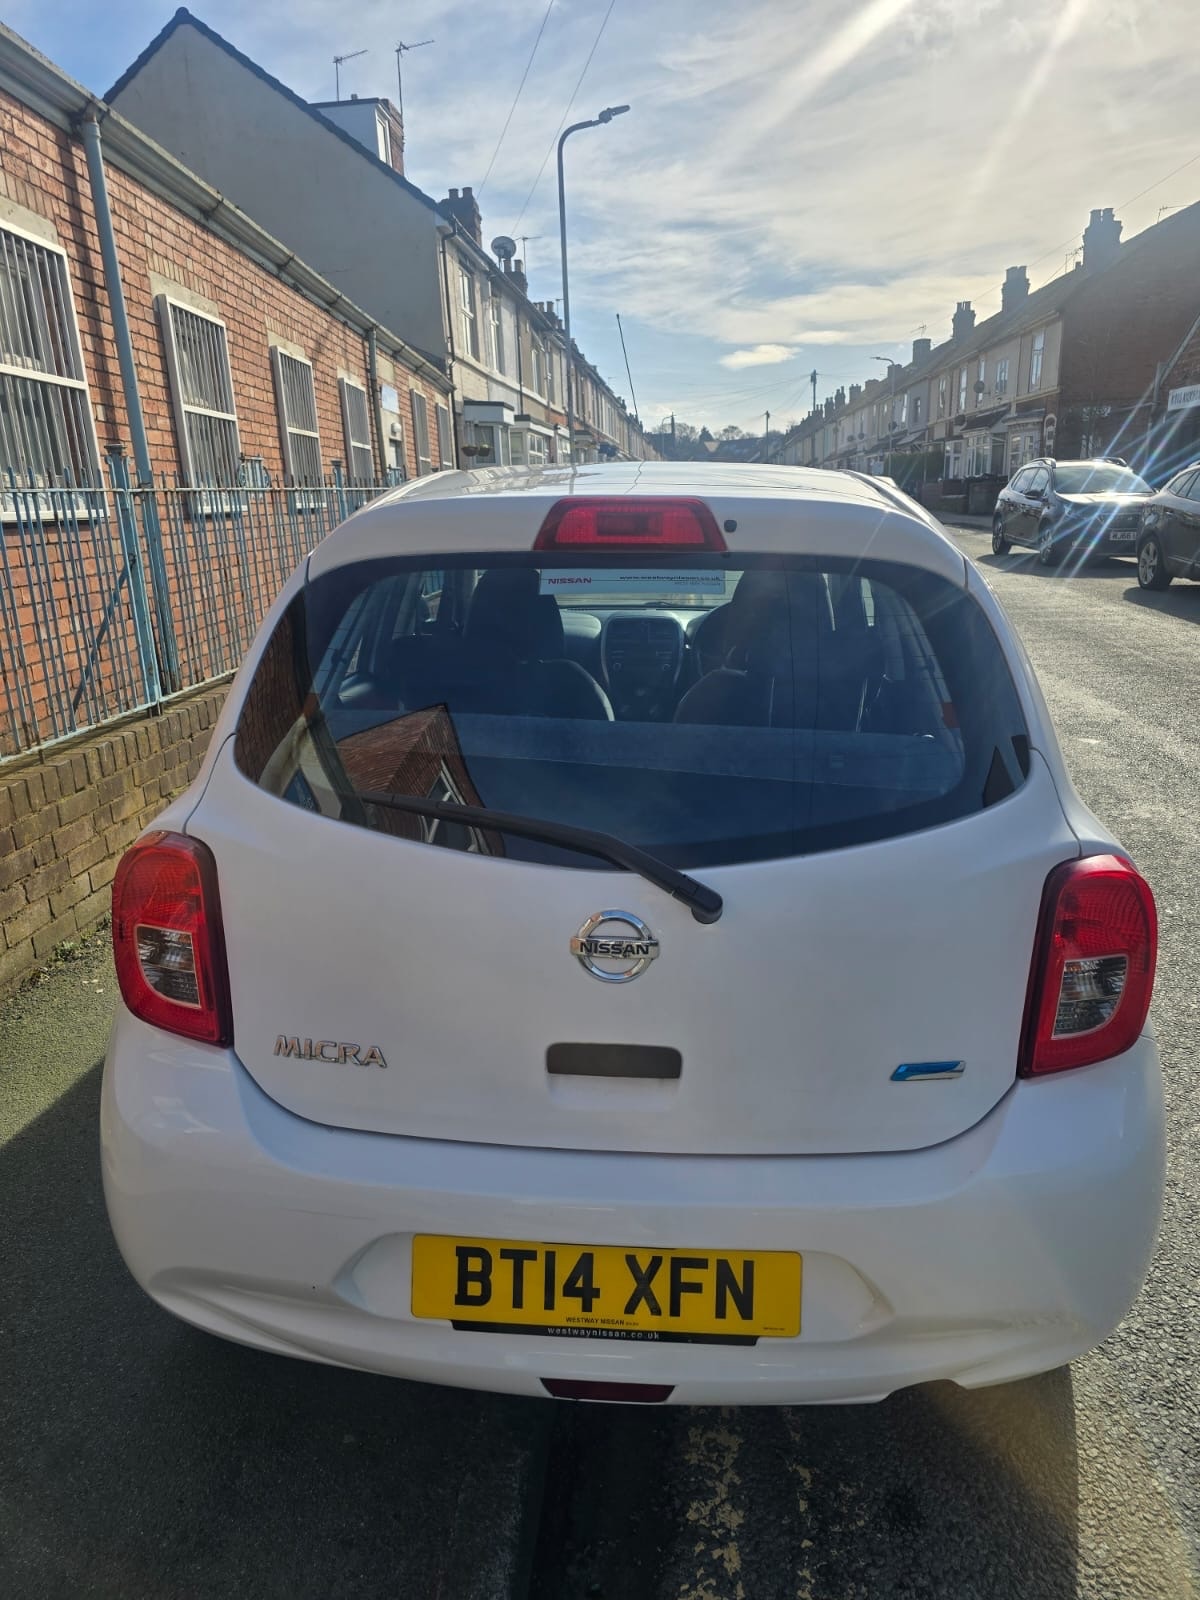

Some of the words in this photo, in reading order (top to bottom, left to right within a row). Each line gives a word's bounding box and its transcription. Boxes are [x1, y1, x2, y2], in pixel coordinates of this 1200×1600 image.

[548, 577, 592, 585] NISSAN
[580, 941, 650, 956] NISSAN
[273, 1034, 388, 1068] MICRA
[454, 1245, 601, 1313] BT14
[623, 1253, 756, 1321] XFN
[565, 1316, 598, 1325] WESTWAY
[600, 1317, 625, 1325] NISSAN
[548, 1327, 660, 1339] westwaynissan.co.uk
